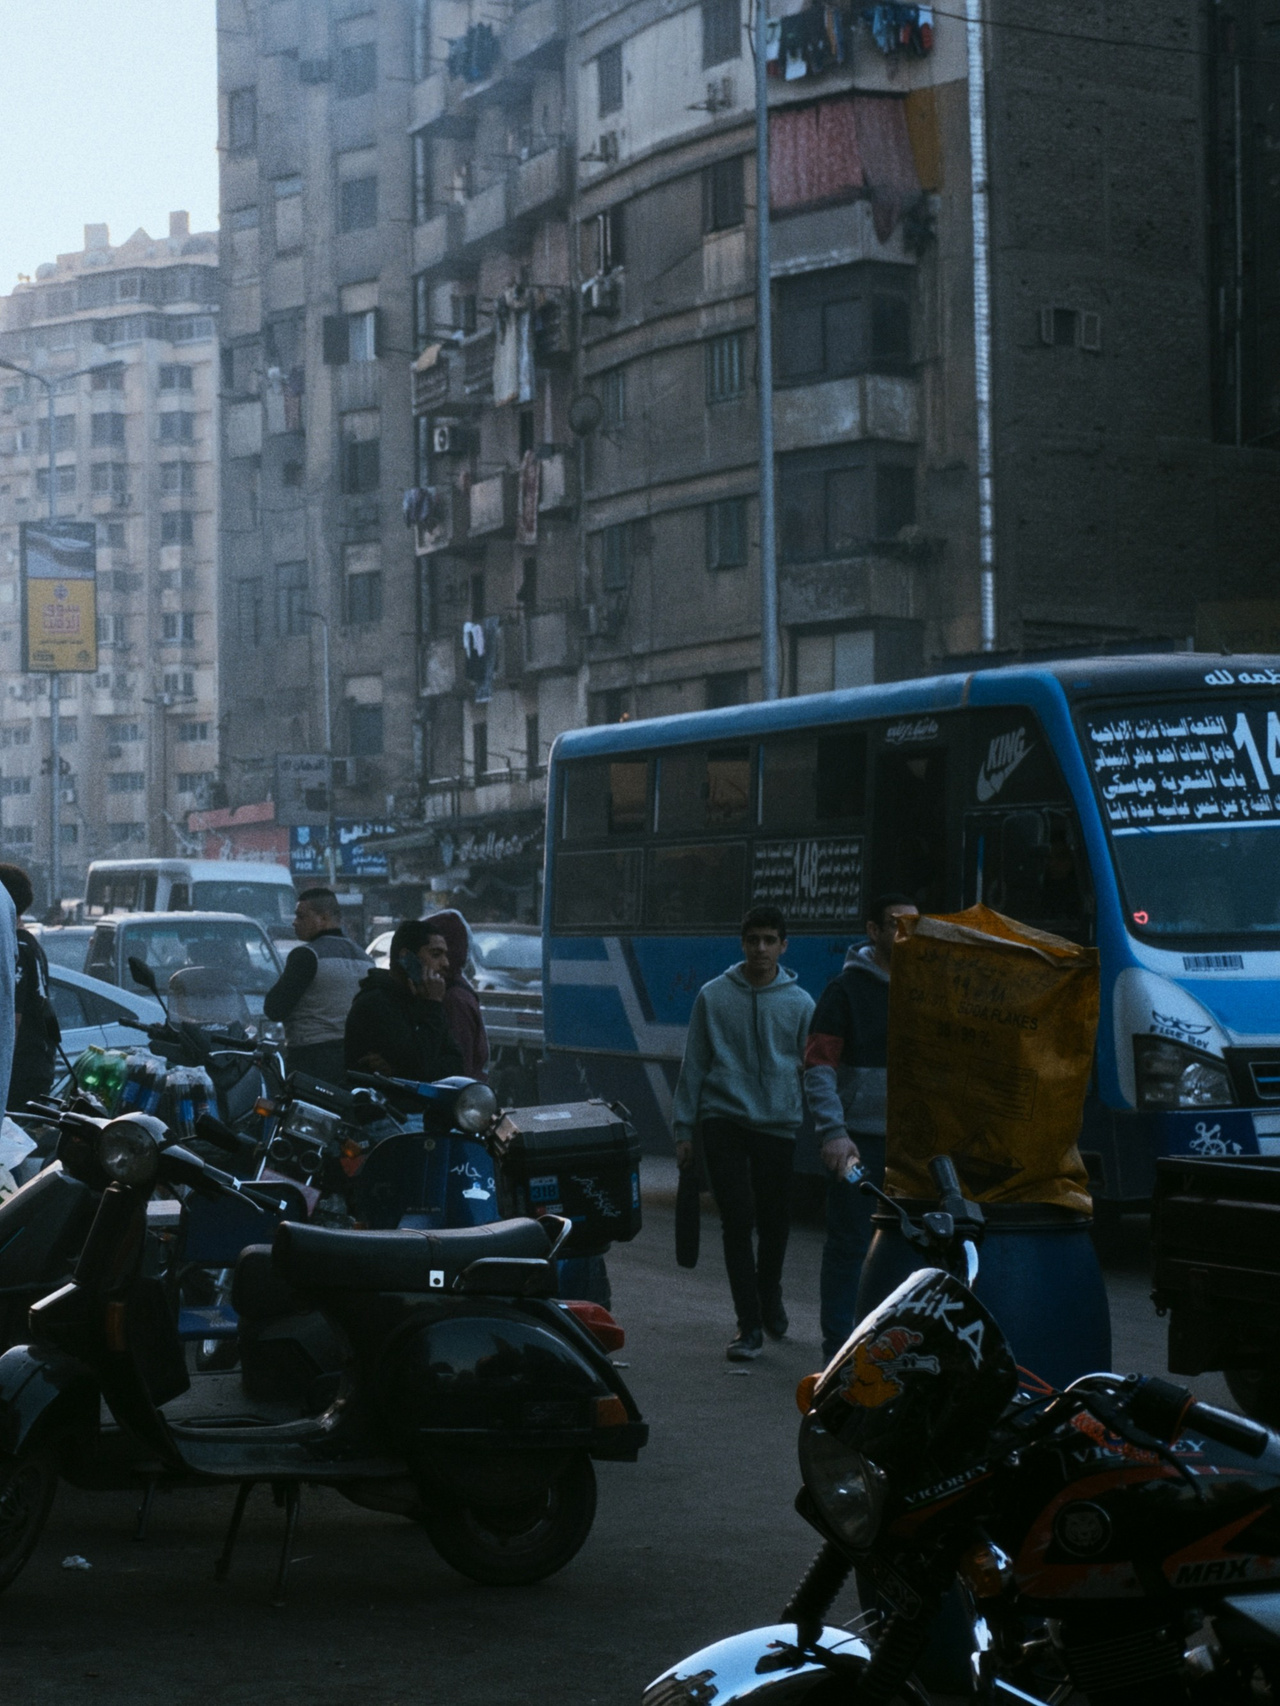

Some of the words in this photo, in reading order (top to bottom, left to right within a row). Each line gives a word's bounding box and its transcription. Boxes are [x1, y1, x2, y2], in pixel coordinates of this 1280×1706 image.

[1204, 668, 1235, 686] لله
[1189, 714, 1228, 735] القلعة
[1158, 768, 1218, 795] الشعرية
[1219, 767, 1247, 792] باب
[793, 841, 819, 899] 148
[990, 1008, 1039, 1031] FLAKES
[904, 1461, 989, 1504] VIGOREY
[1176, 1558, 1252, 1584] MAX
